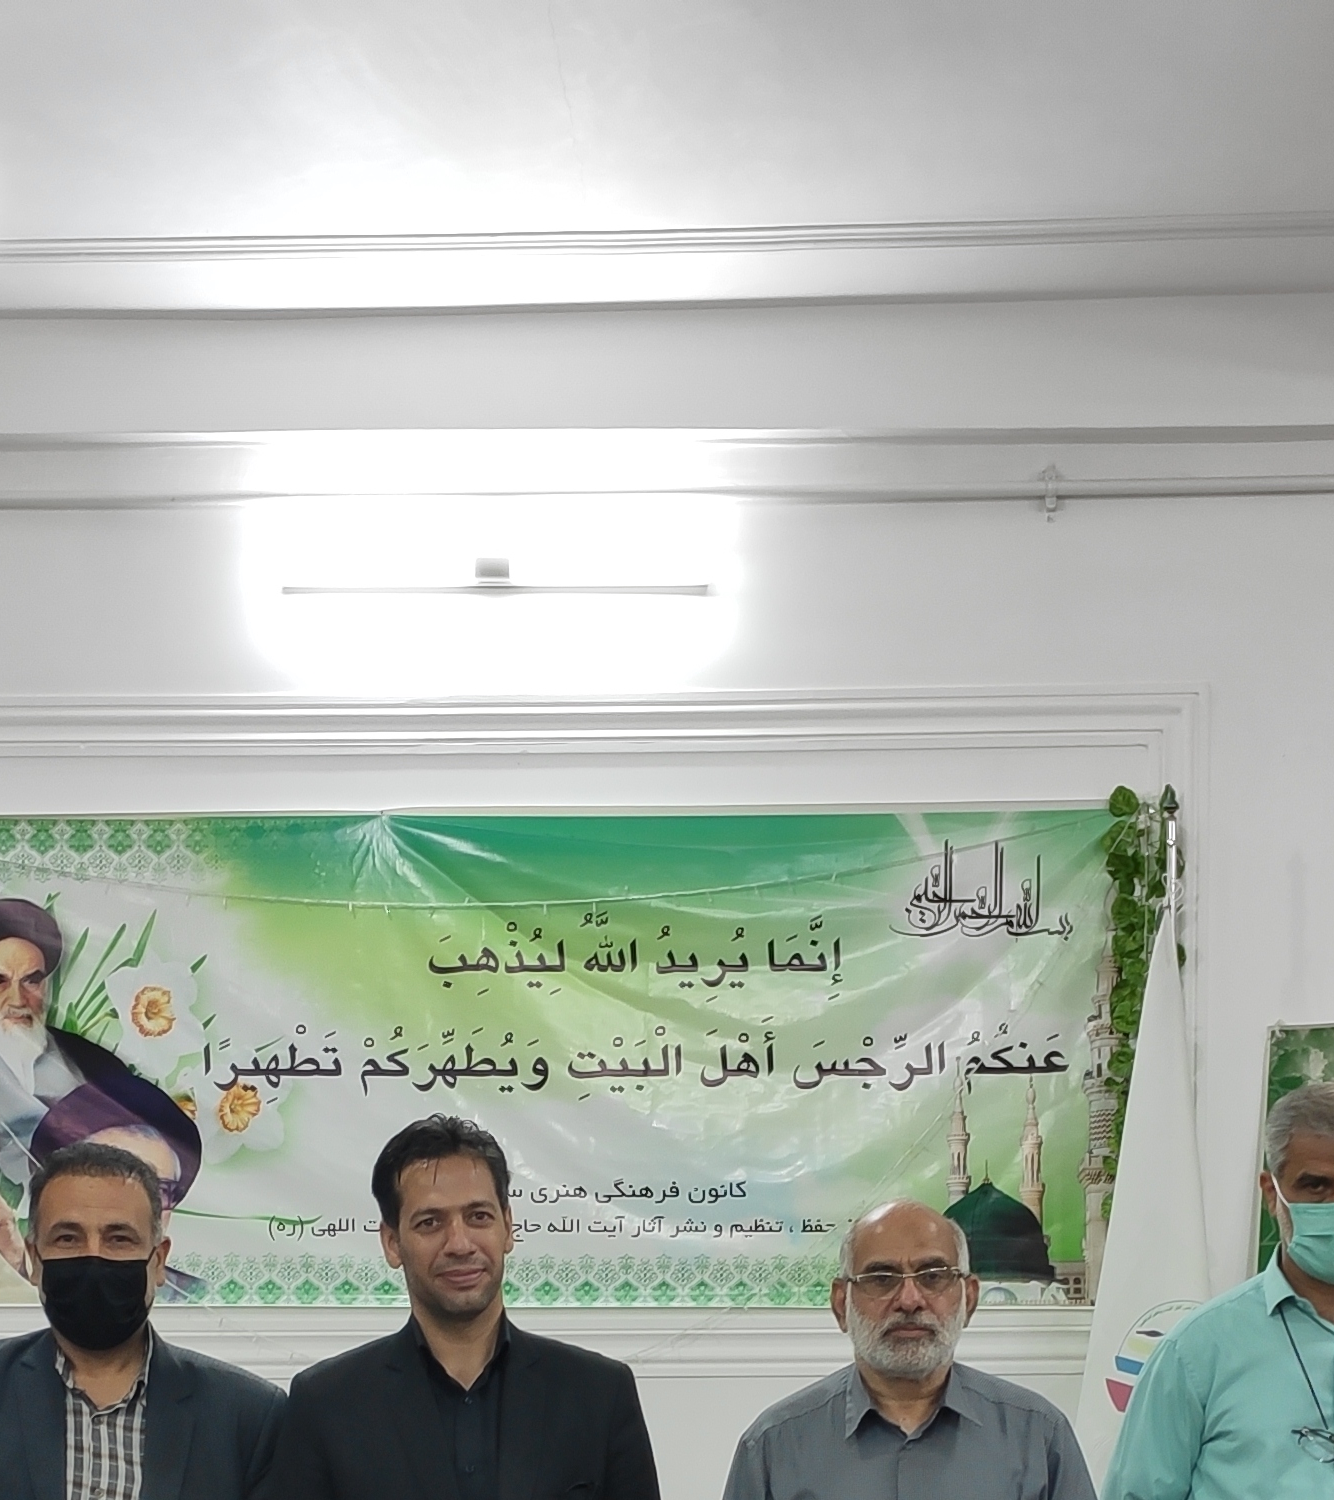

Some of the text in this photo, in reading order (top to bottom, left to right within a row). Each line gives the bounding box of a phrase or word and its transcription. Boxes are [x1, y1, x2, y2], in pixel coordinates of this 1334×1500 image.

[531, 1184, 588, 1204] هنری
[595, 1178, 680, 1204] فرهنگی
[688, 1180, 747, 1204] کانون
[311, 1218, 355, 1237] اللهی
[512, 1218, 542, 1242] حاج
[587, 1215, 625, 1238] آیت
[631, 1215, 666, 1239] آثار
[669, 1218, 706, 1239] نشر
[713, 1225, 722, 1239] و
[730, 1217, 783, 1239] تنظیم
